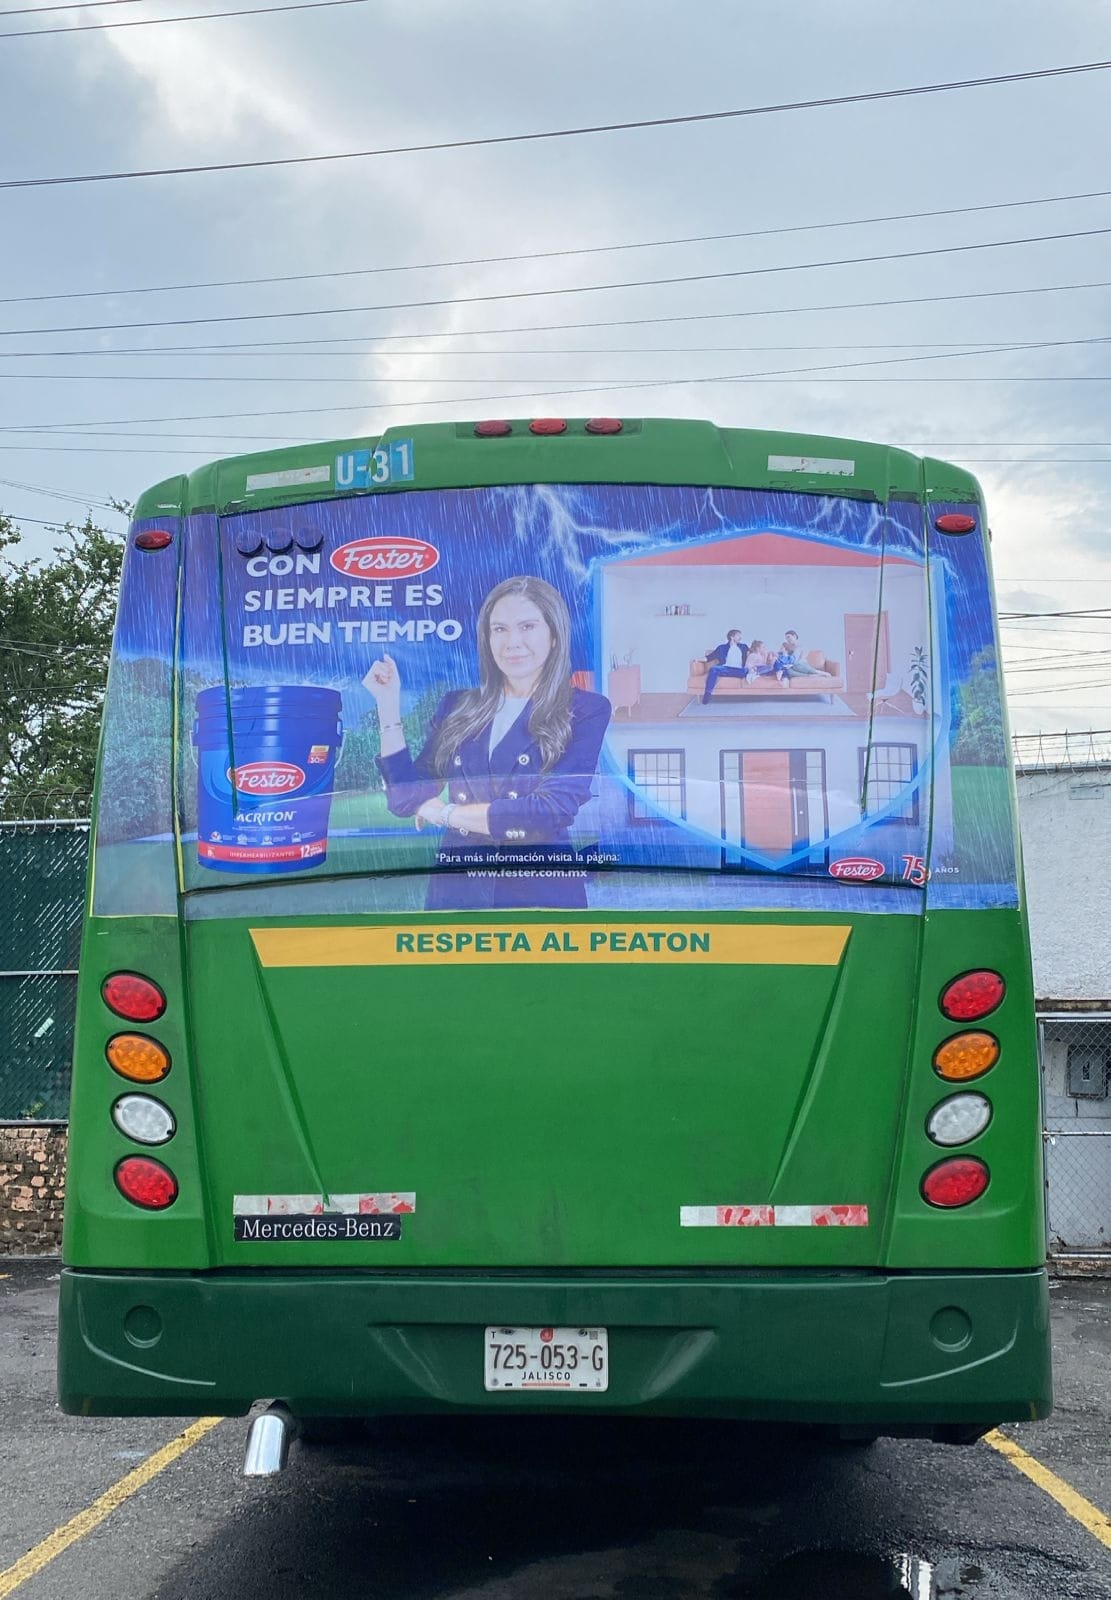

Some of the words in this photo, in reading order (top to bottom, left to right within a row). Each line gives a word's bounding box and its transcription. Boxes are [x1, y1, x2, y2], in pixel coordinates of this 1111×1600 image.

[336, 443, 409, 485] U-31
[246, 553, 321, 577] CON
[343, 544, 427, 571] Fester
[244, 585, 393, 611] SIEMPRE
[405, 584, 443, 607] ES
[243, 621, 331, 647] BUEN
[338, 619, 463, 643] TIEMPO
[237, 768, 299, 788] Fester
[300, 845, 311, 858] 12
[465, 853, 484, 862] más
[487, 853, 544, 862] información
[548, 852, 572, 862] visita
[576, 852, 584, 862] la
[467, 869, 588, 878] www.fester.com.mx
[836, 863, 877, 876] Fester
[902, 855, 931, 886] 75
[935, 866, 960, 874] AÑOS
[396, 932, 531, 953] RESPETA
[541, 932, 579, 952] AL
[590, 931, 711, 953] PEATON
[242, 1218, 394, 1239] Mercedes-Benz
[490, 1344, 603, 1371] 725-053-G
[522, 1371, 571, 1381] JALISCO
